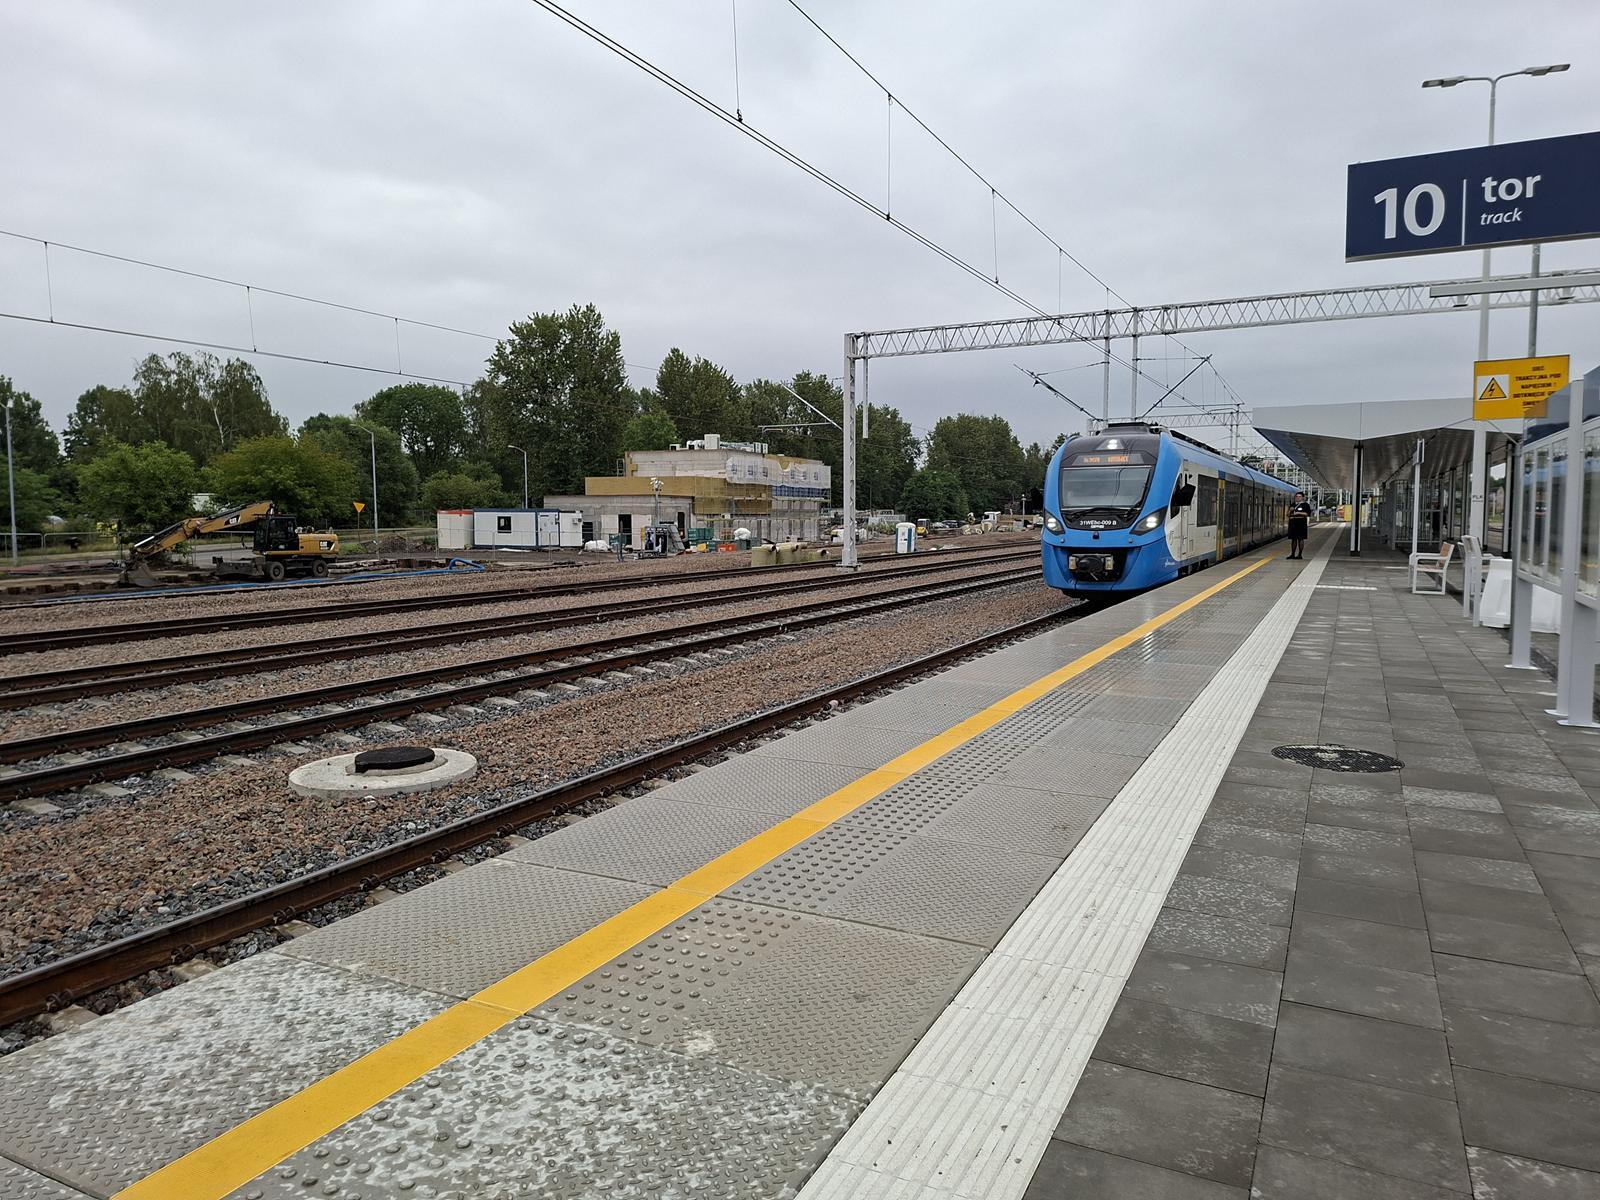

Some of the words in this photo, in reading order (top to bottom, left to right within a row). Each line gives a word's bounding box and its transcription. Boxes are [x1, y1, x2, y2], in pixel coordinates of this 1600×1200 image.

[1481, 174, 1542, 203] tor
[1373, 182, 1446, 240] 10
[1480, 208, 1524, 226] track
